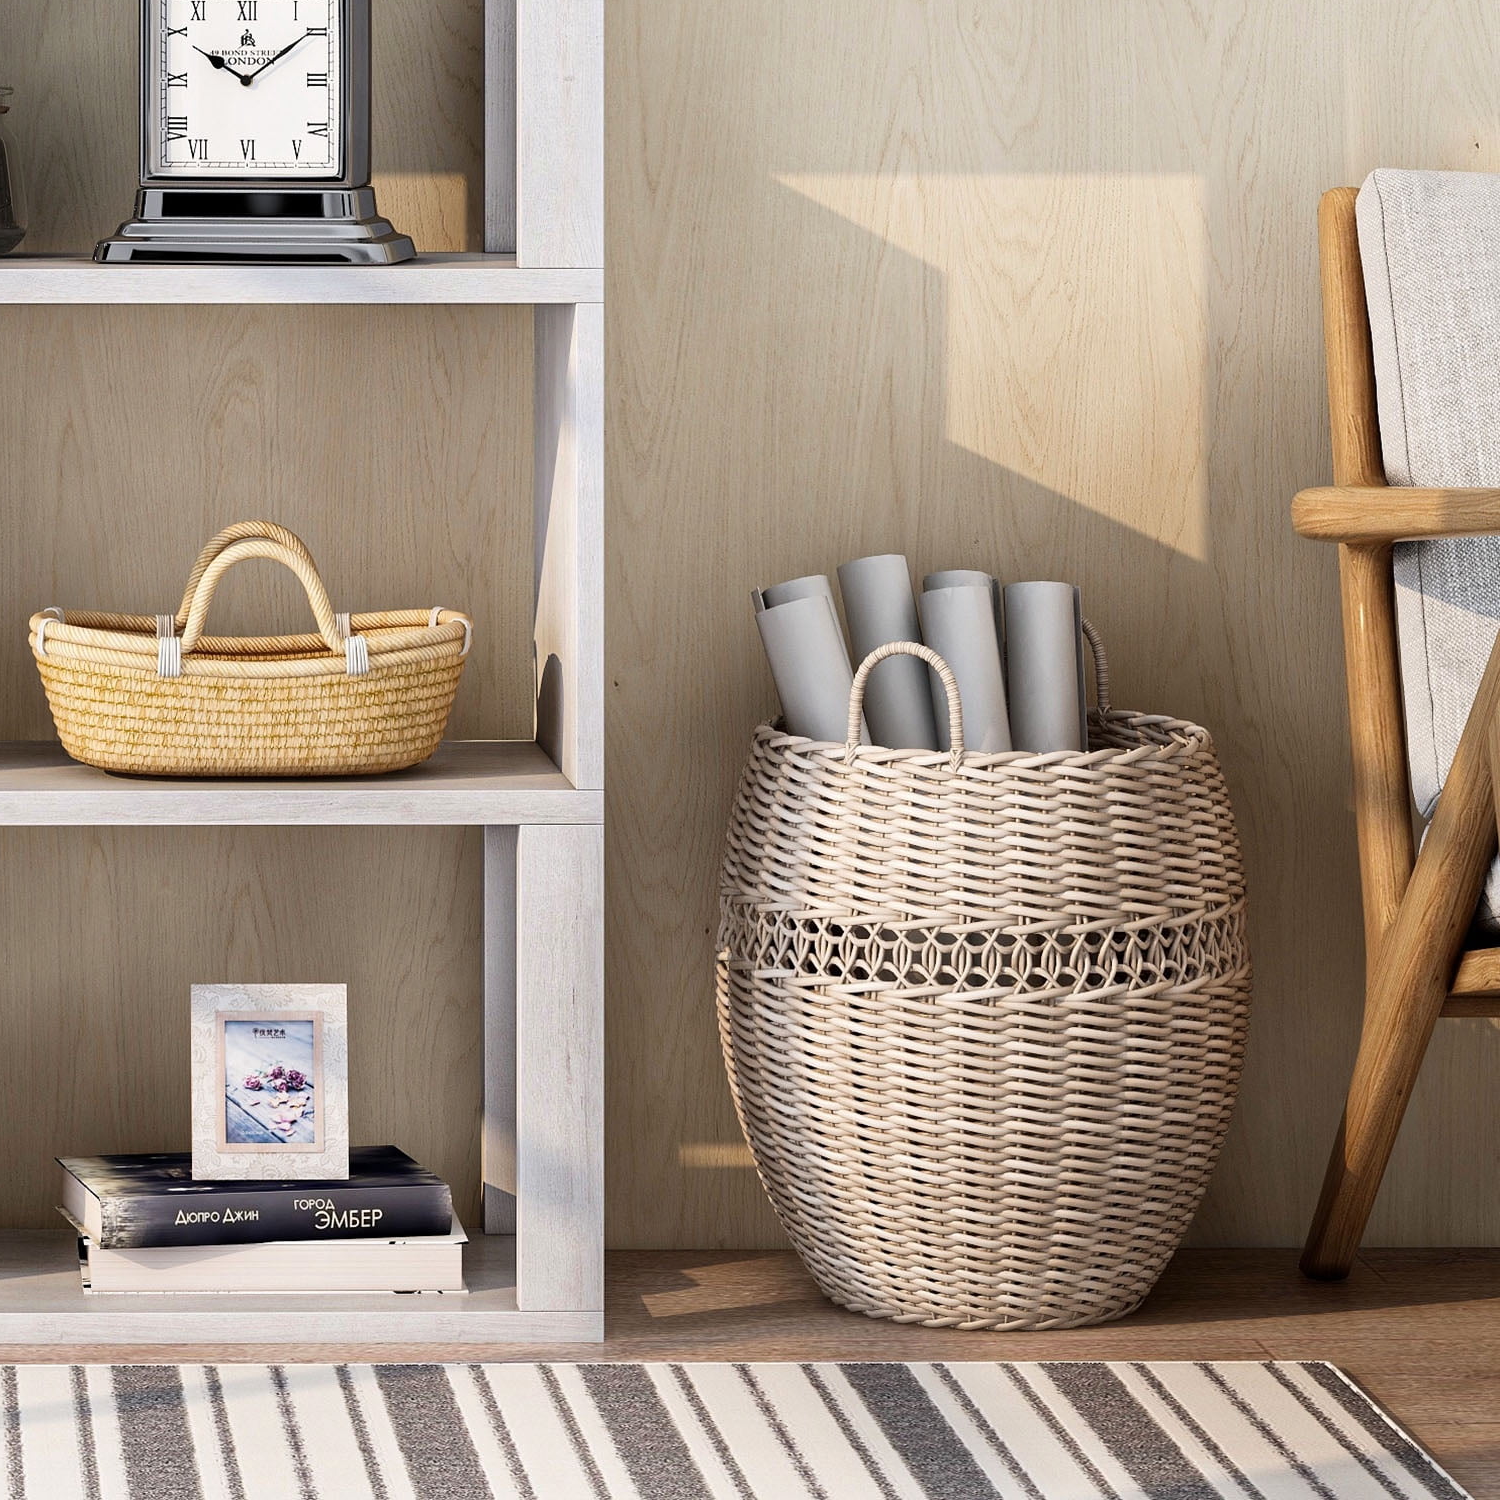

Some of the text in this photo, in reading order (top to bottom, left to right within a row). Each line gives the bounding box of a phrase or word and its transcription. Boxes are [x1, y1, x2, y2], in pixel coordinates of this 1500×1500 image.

[191, 1, 206, 21] XI
[237, 1, 257, 21] XII
[167, 27, 187, 36] X
[306, 27, 327, 36] II
[224, 57, 275, 65] ONDON
[167, 73, 187, 87] IX
[307, 73, 327, 87] III
[167, 116, 187, 141] VIII
[307, 123, 327, 137] IV
[188, 139, 208, 160] VII
[240, 139, 256, 160] VI
[292, 139, 302, 160] V
[294, 1198, 335, 1211] ГОРОД
[314, 1209, 383, 1230] ЭМБЕР
